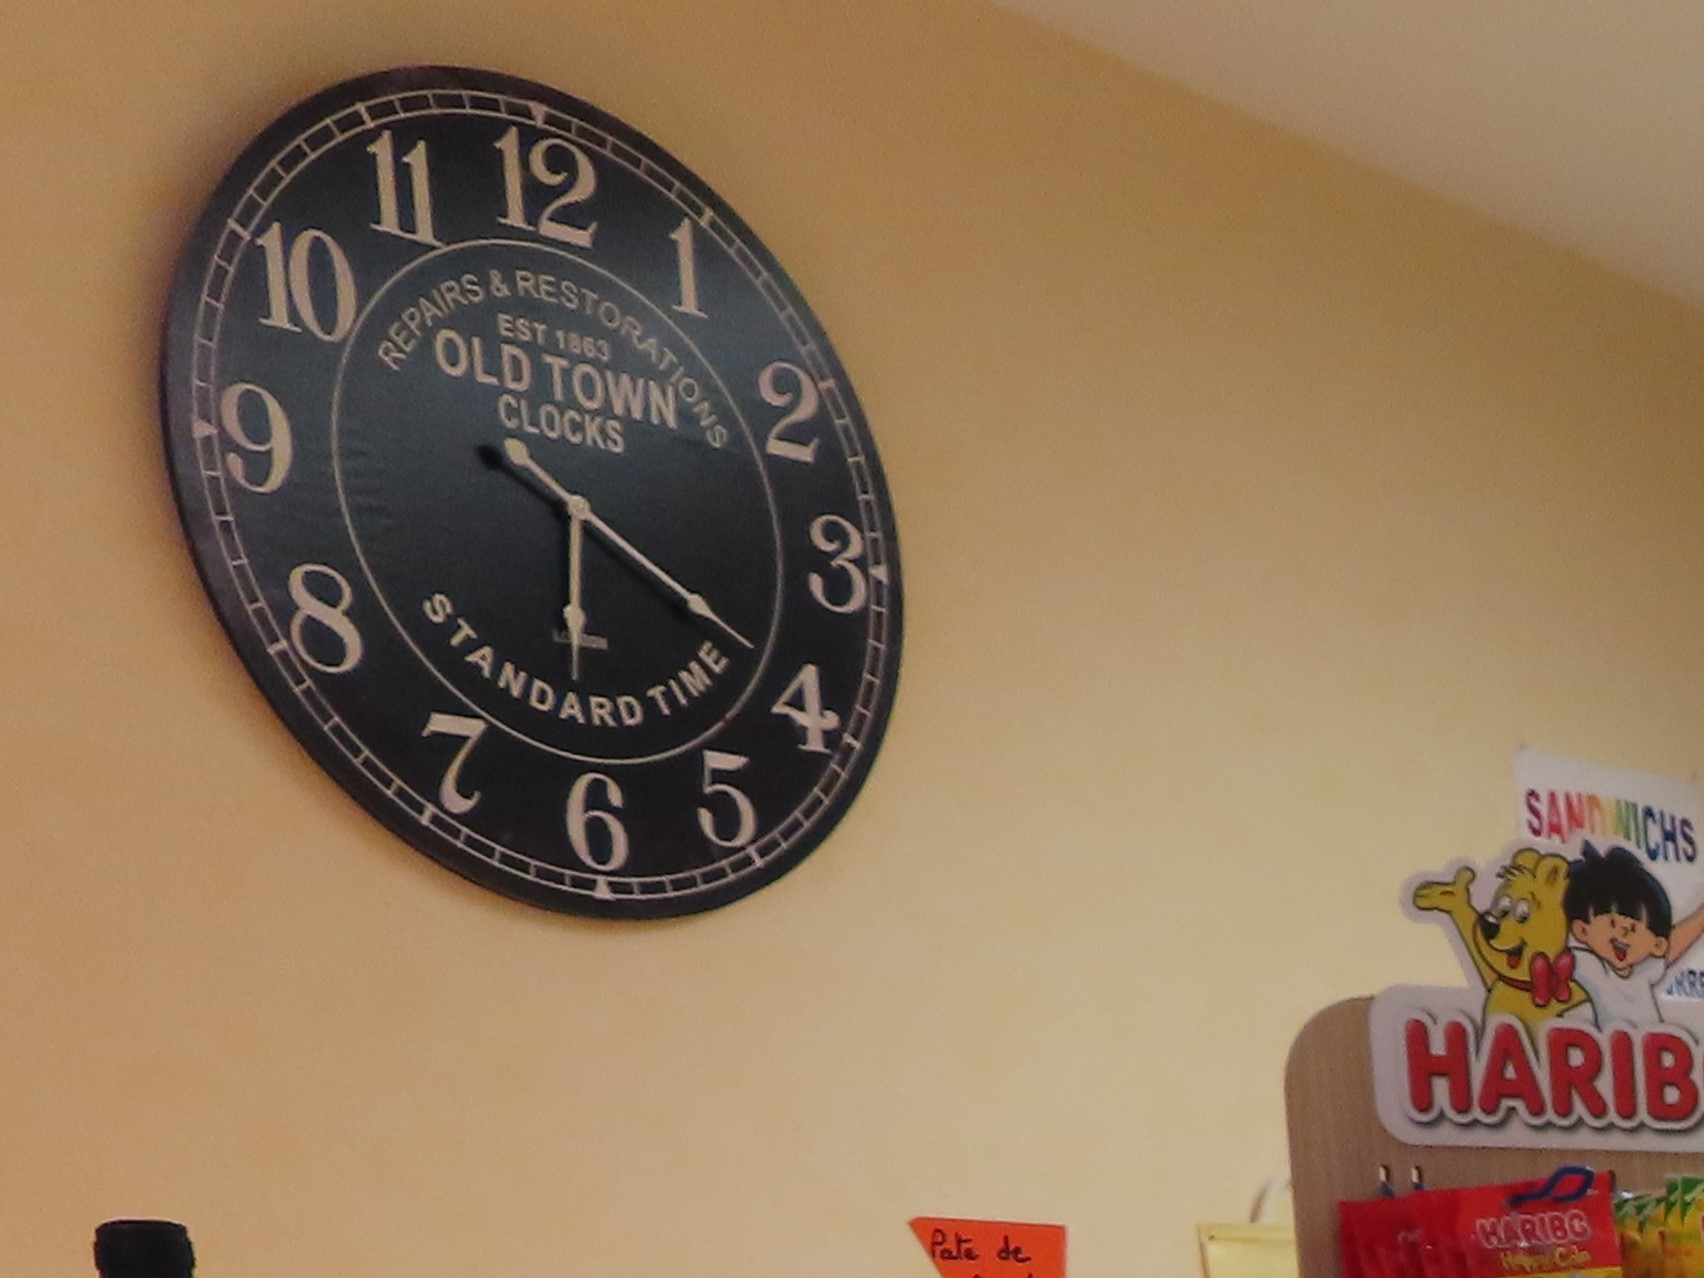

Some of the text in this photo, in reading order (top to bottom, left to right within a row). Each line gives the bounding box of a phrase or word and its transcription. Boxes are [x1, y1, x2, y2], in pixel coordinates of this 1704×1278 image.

[368, 130, 443, 250] 11
[495, 126, 598, 250] 12
[255, 220, 358, 343] 10
[669, 217, 708, 320] 1
[378, 273, 485, 372] REPAIRS
[515, 270, 729, 449] RESTORATIONS
[435, 328, 679, 430] OLD TOWN
[497, 313, 547, 346] EST
[221, 381, 293, 494] 9
[499, 393, 625, 454] CLOCKS
[759, 361, 821, 462] 2
[808, 514, 866, 614] 3
[288, 562, 363, 673] 8
[423, 593, 731, 728] STANDARD TIME
[771, 663, 841, 754] 4
[421, 713, 489, 814] 7
[697, 749, 756, 848] 5
[565, 771, 629, 872] 6
[996, 1234, 1032, 1264] de
